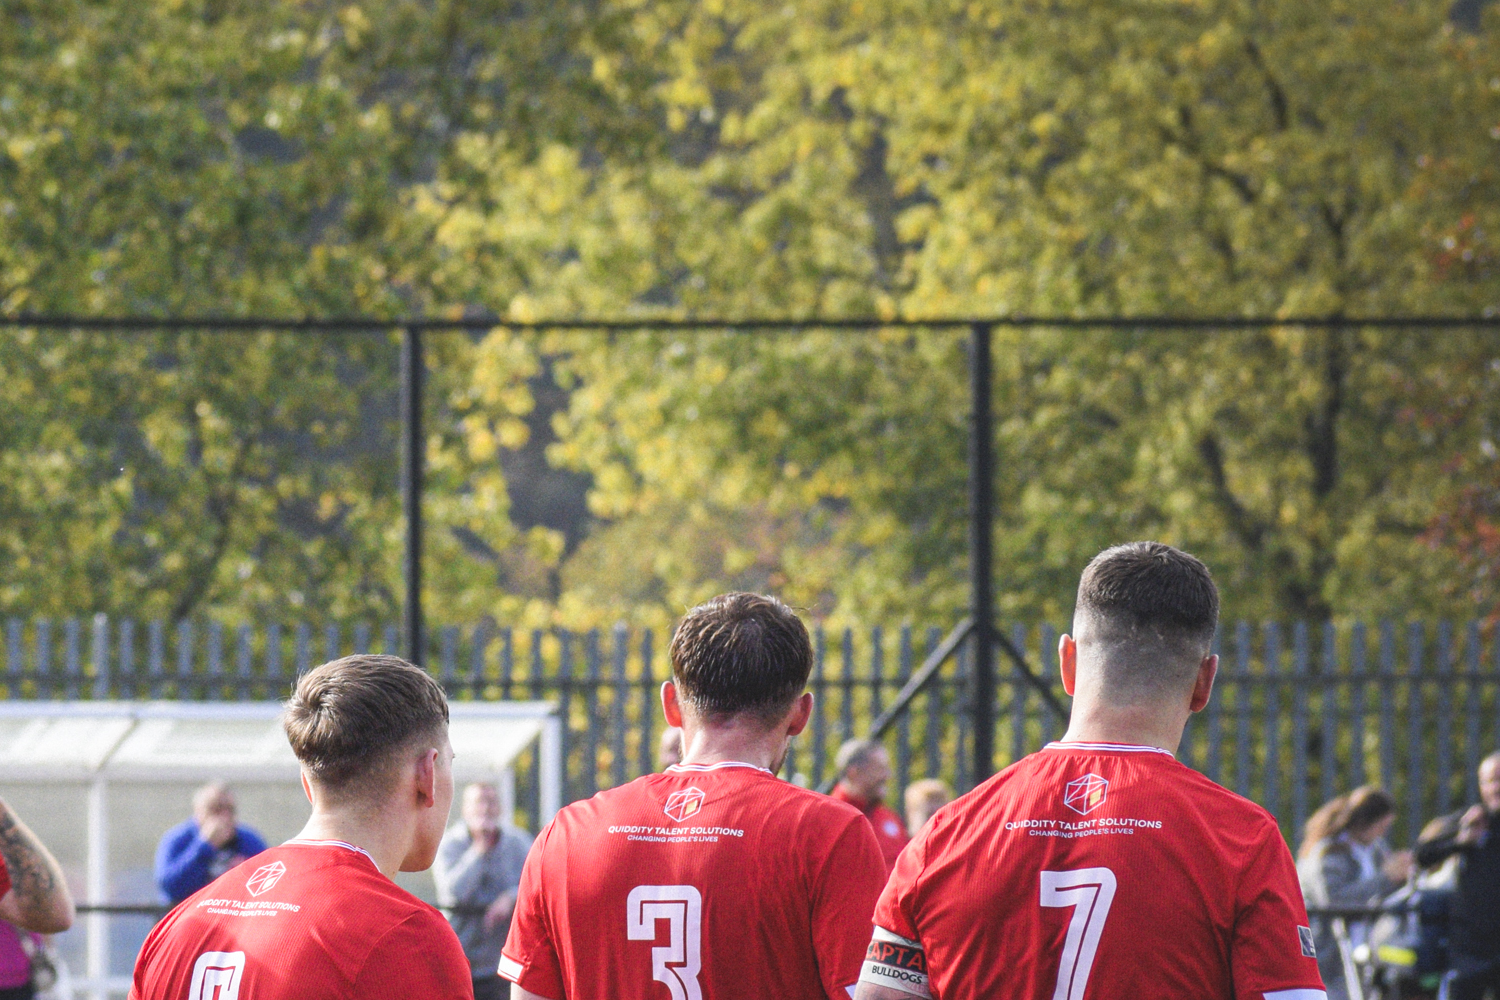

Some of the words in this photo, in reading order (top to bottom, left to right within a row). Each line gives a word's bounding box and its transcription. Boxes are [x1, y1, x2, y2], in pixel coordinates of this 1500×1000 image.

[1005, 819, 1056, 830] QUIDDITY
[1058, 819, 1097, 830] TALENT
[1099, 818, 1162, 829] SOLUTIONS
[608, 825, 653, 834] QUIDDITY
[655, 827, 689, 835] TALENT
[690, 827, 744, 837] SOLUTIONS
[1029, 830, 1073, 838] CHANGING
[627, 834, 666, 842] CHANGING
[871, 965, 922, 984] BULLDOGS
